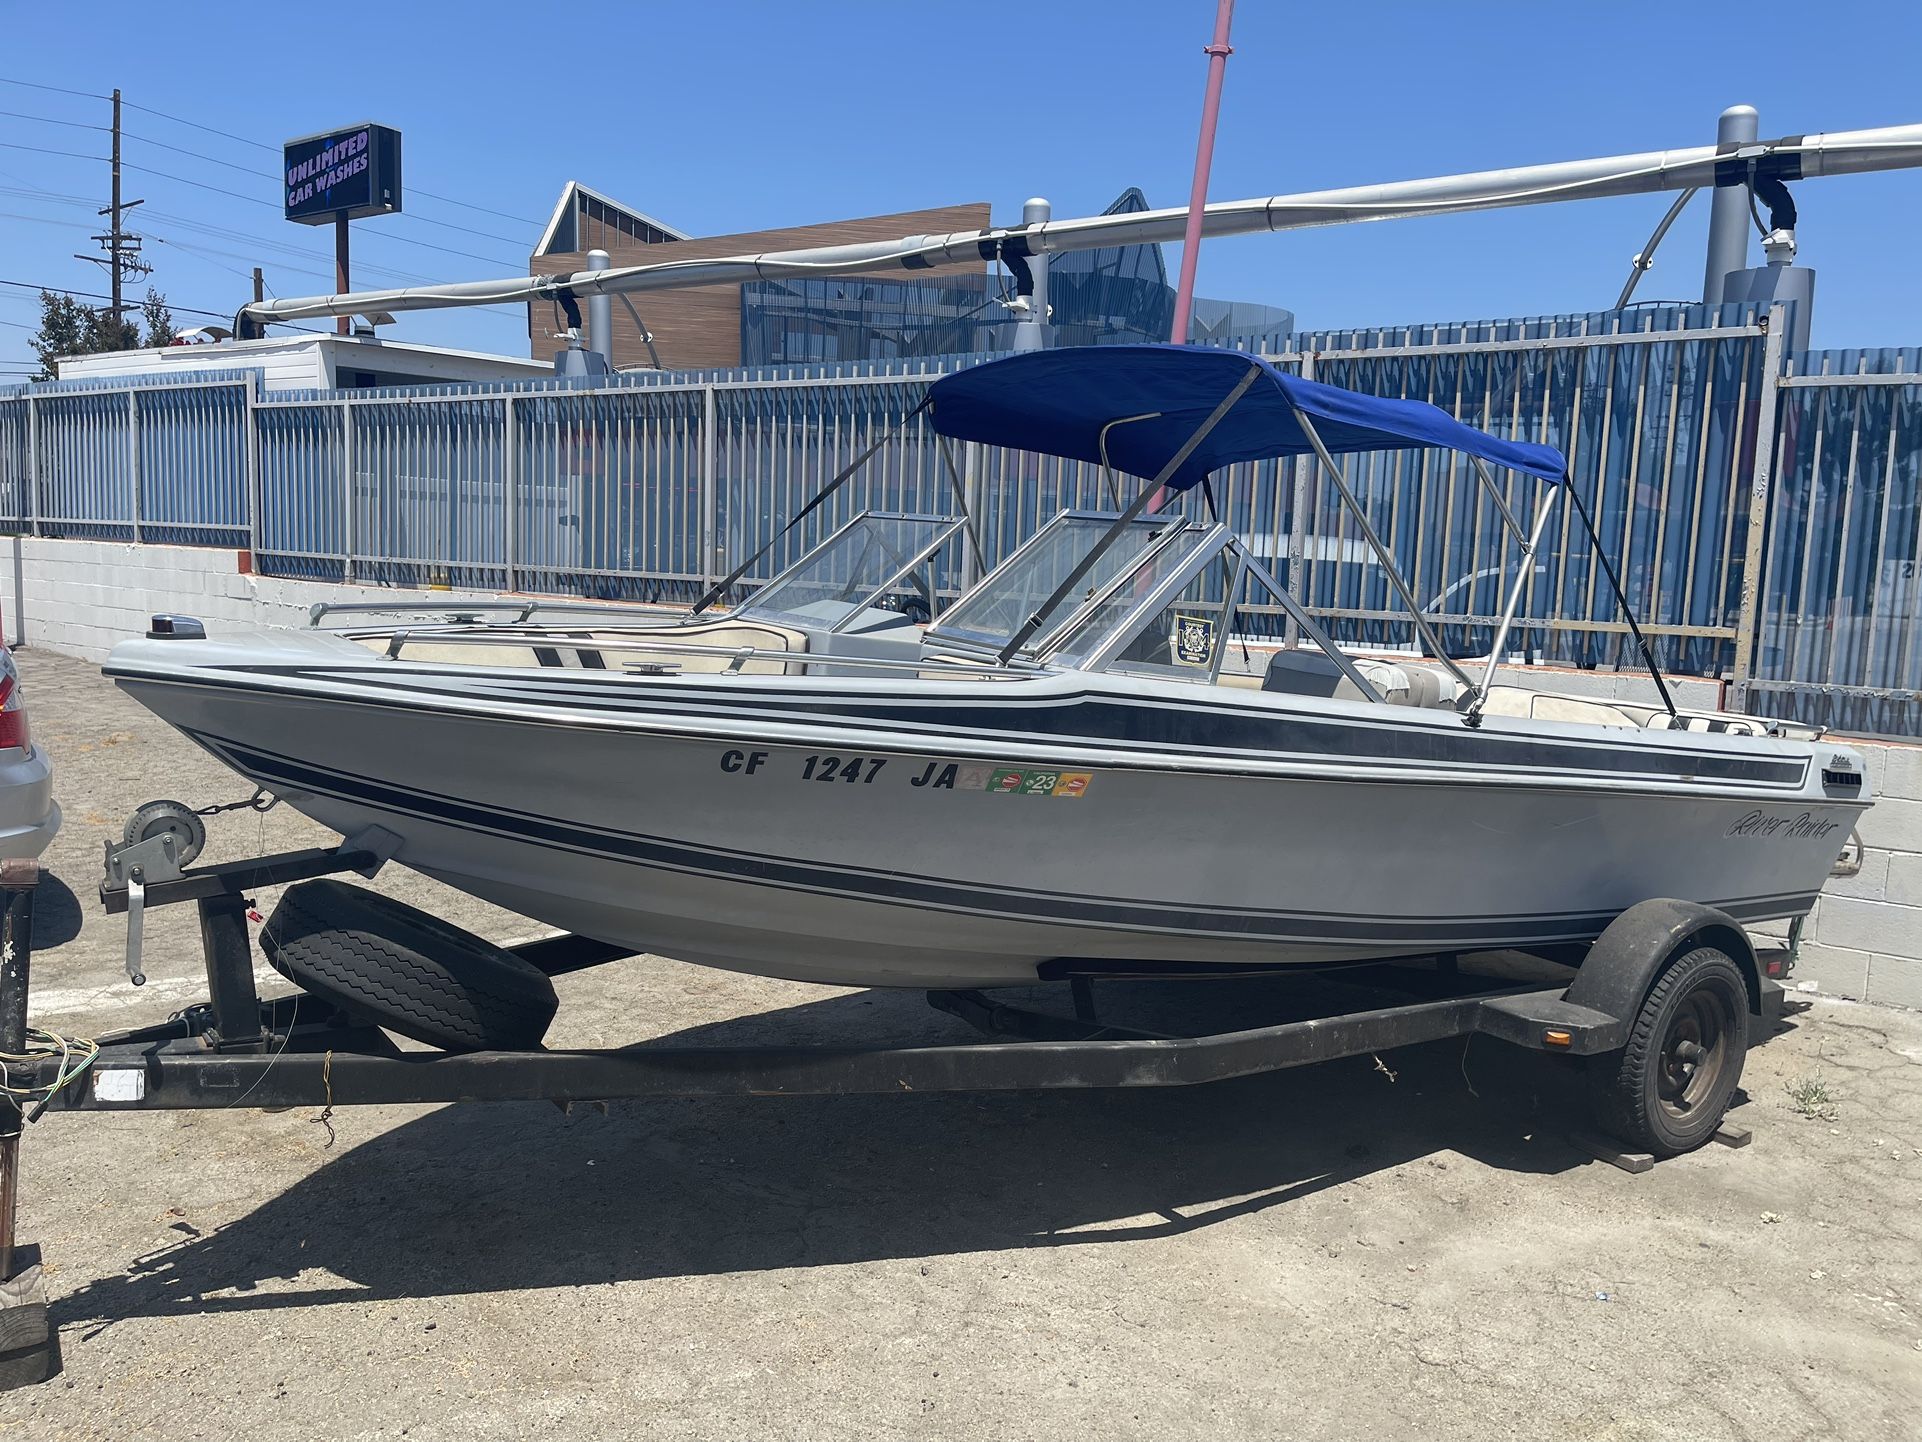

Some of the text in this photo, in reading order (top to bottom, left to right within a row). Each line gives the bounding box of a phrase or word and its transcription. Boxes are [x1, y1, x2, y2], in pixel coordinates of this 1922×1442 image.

[288, 131, 368, 186] UNLIMITED
[288, 152, 368, 207] CAR WASHES
[720, 749, 959, 790] CF 1247 JA
[1031, 775, 1057, 790] 23
